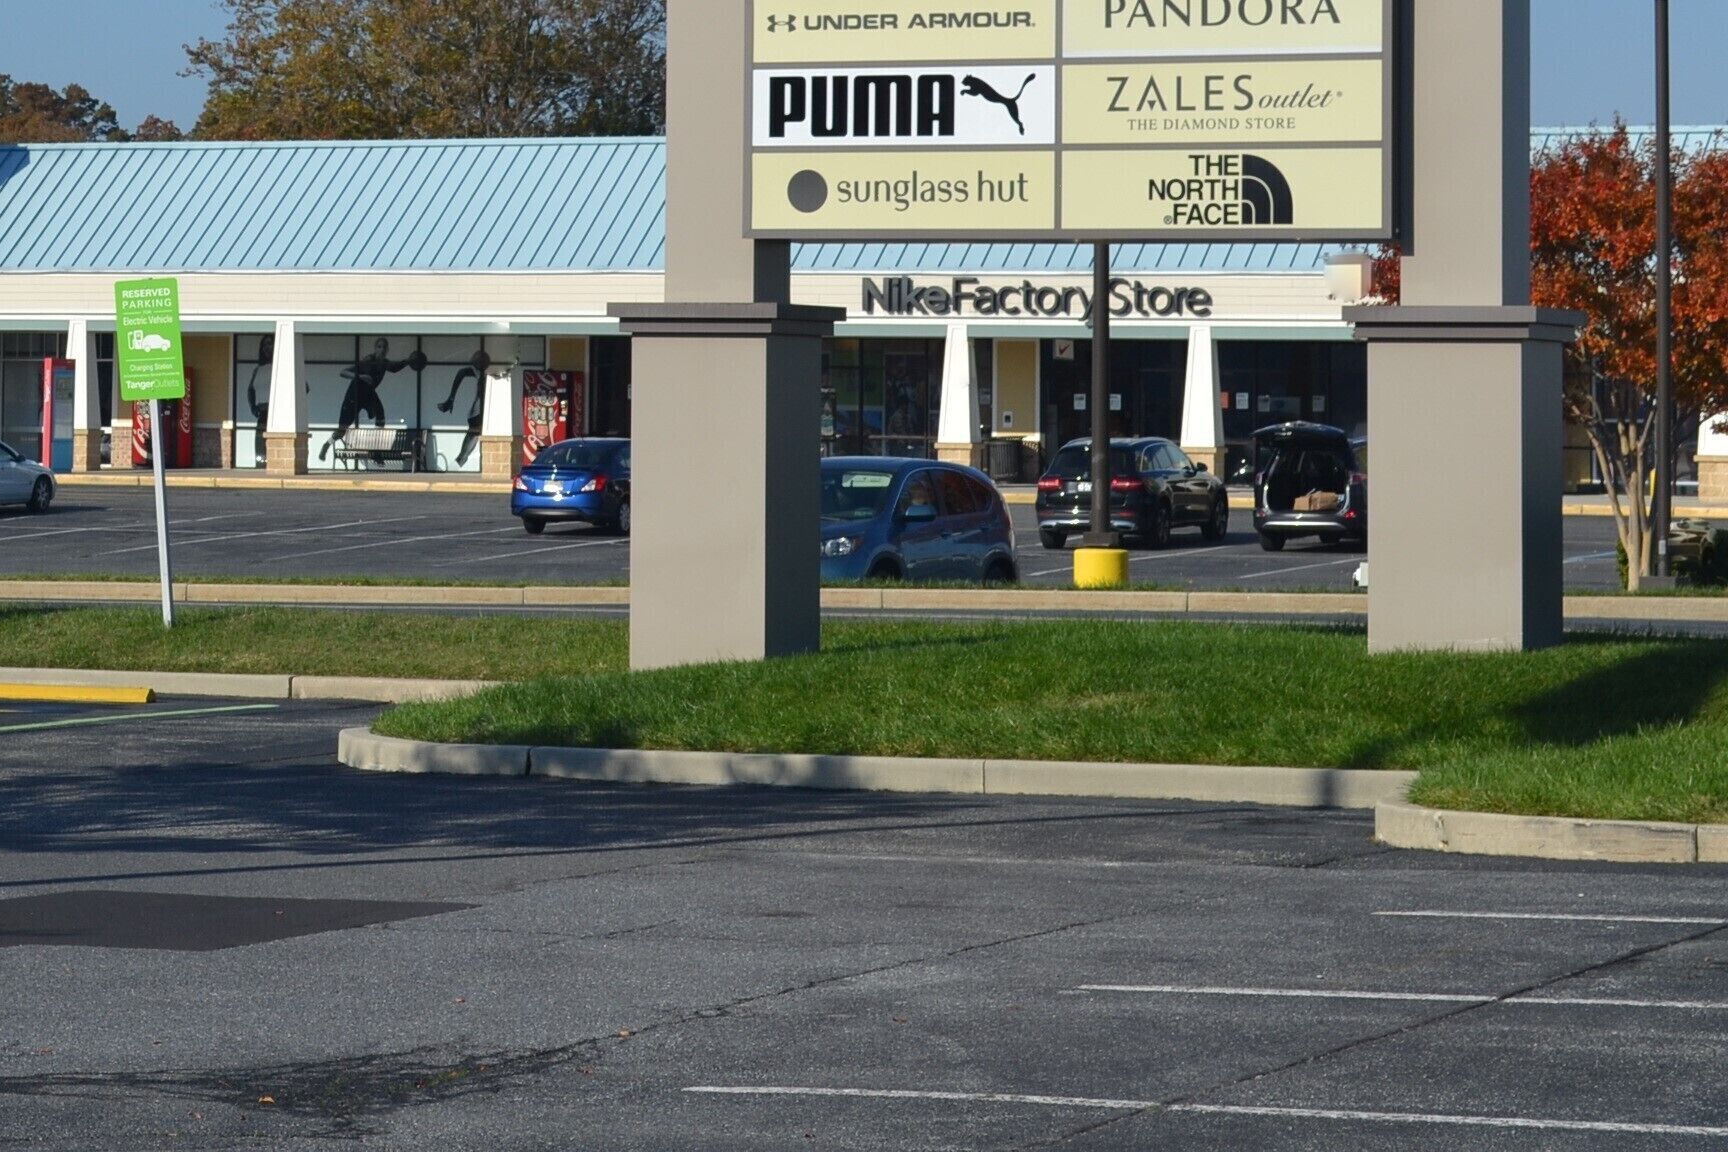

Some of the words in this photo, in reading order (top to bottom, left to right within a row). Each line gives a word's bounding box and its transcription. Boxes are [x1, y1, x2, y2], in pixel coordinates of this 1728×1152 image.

[804, 14, 899, 31] UNDER
[1106, 74, 1254, 112] ZALES
[1258, 83, 1336, 110] outlet
[769, 74, 956, 138] PUMA
[1127, 118, 1158, 131] THE
[1163, 117, 1240, 131] DIAMOND
[1245, 116, 1297, 130] STORE
[1188, 154, 1240, 176] THE
[837, 170, 969, 212] sunglass
[977, 170, 1029, 203] hut
[1148, 178, 1239, 201] NORTH
[122, 288, 171, 298] RESERVED
[122, 298, 172, 309] PARKING
[861, 275, 953, 316] Nike
[952, 276, 1095, 323] Factory
[1106, 277, 1214, 317] Store
